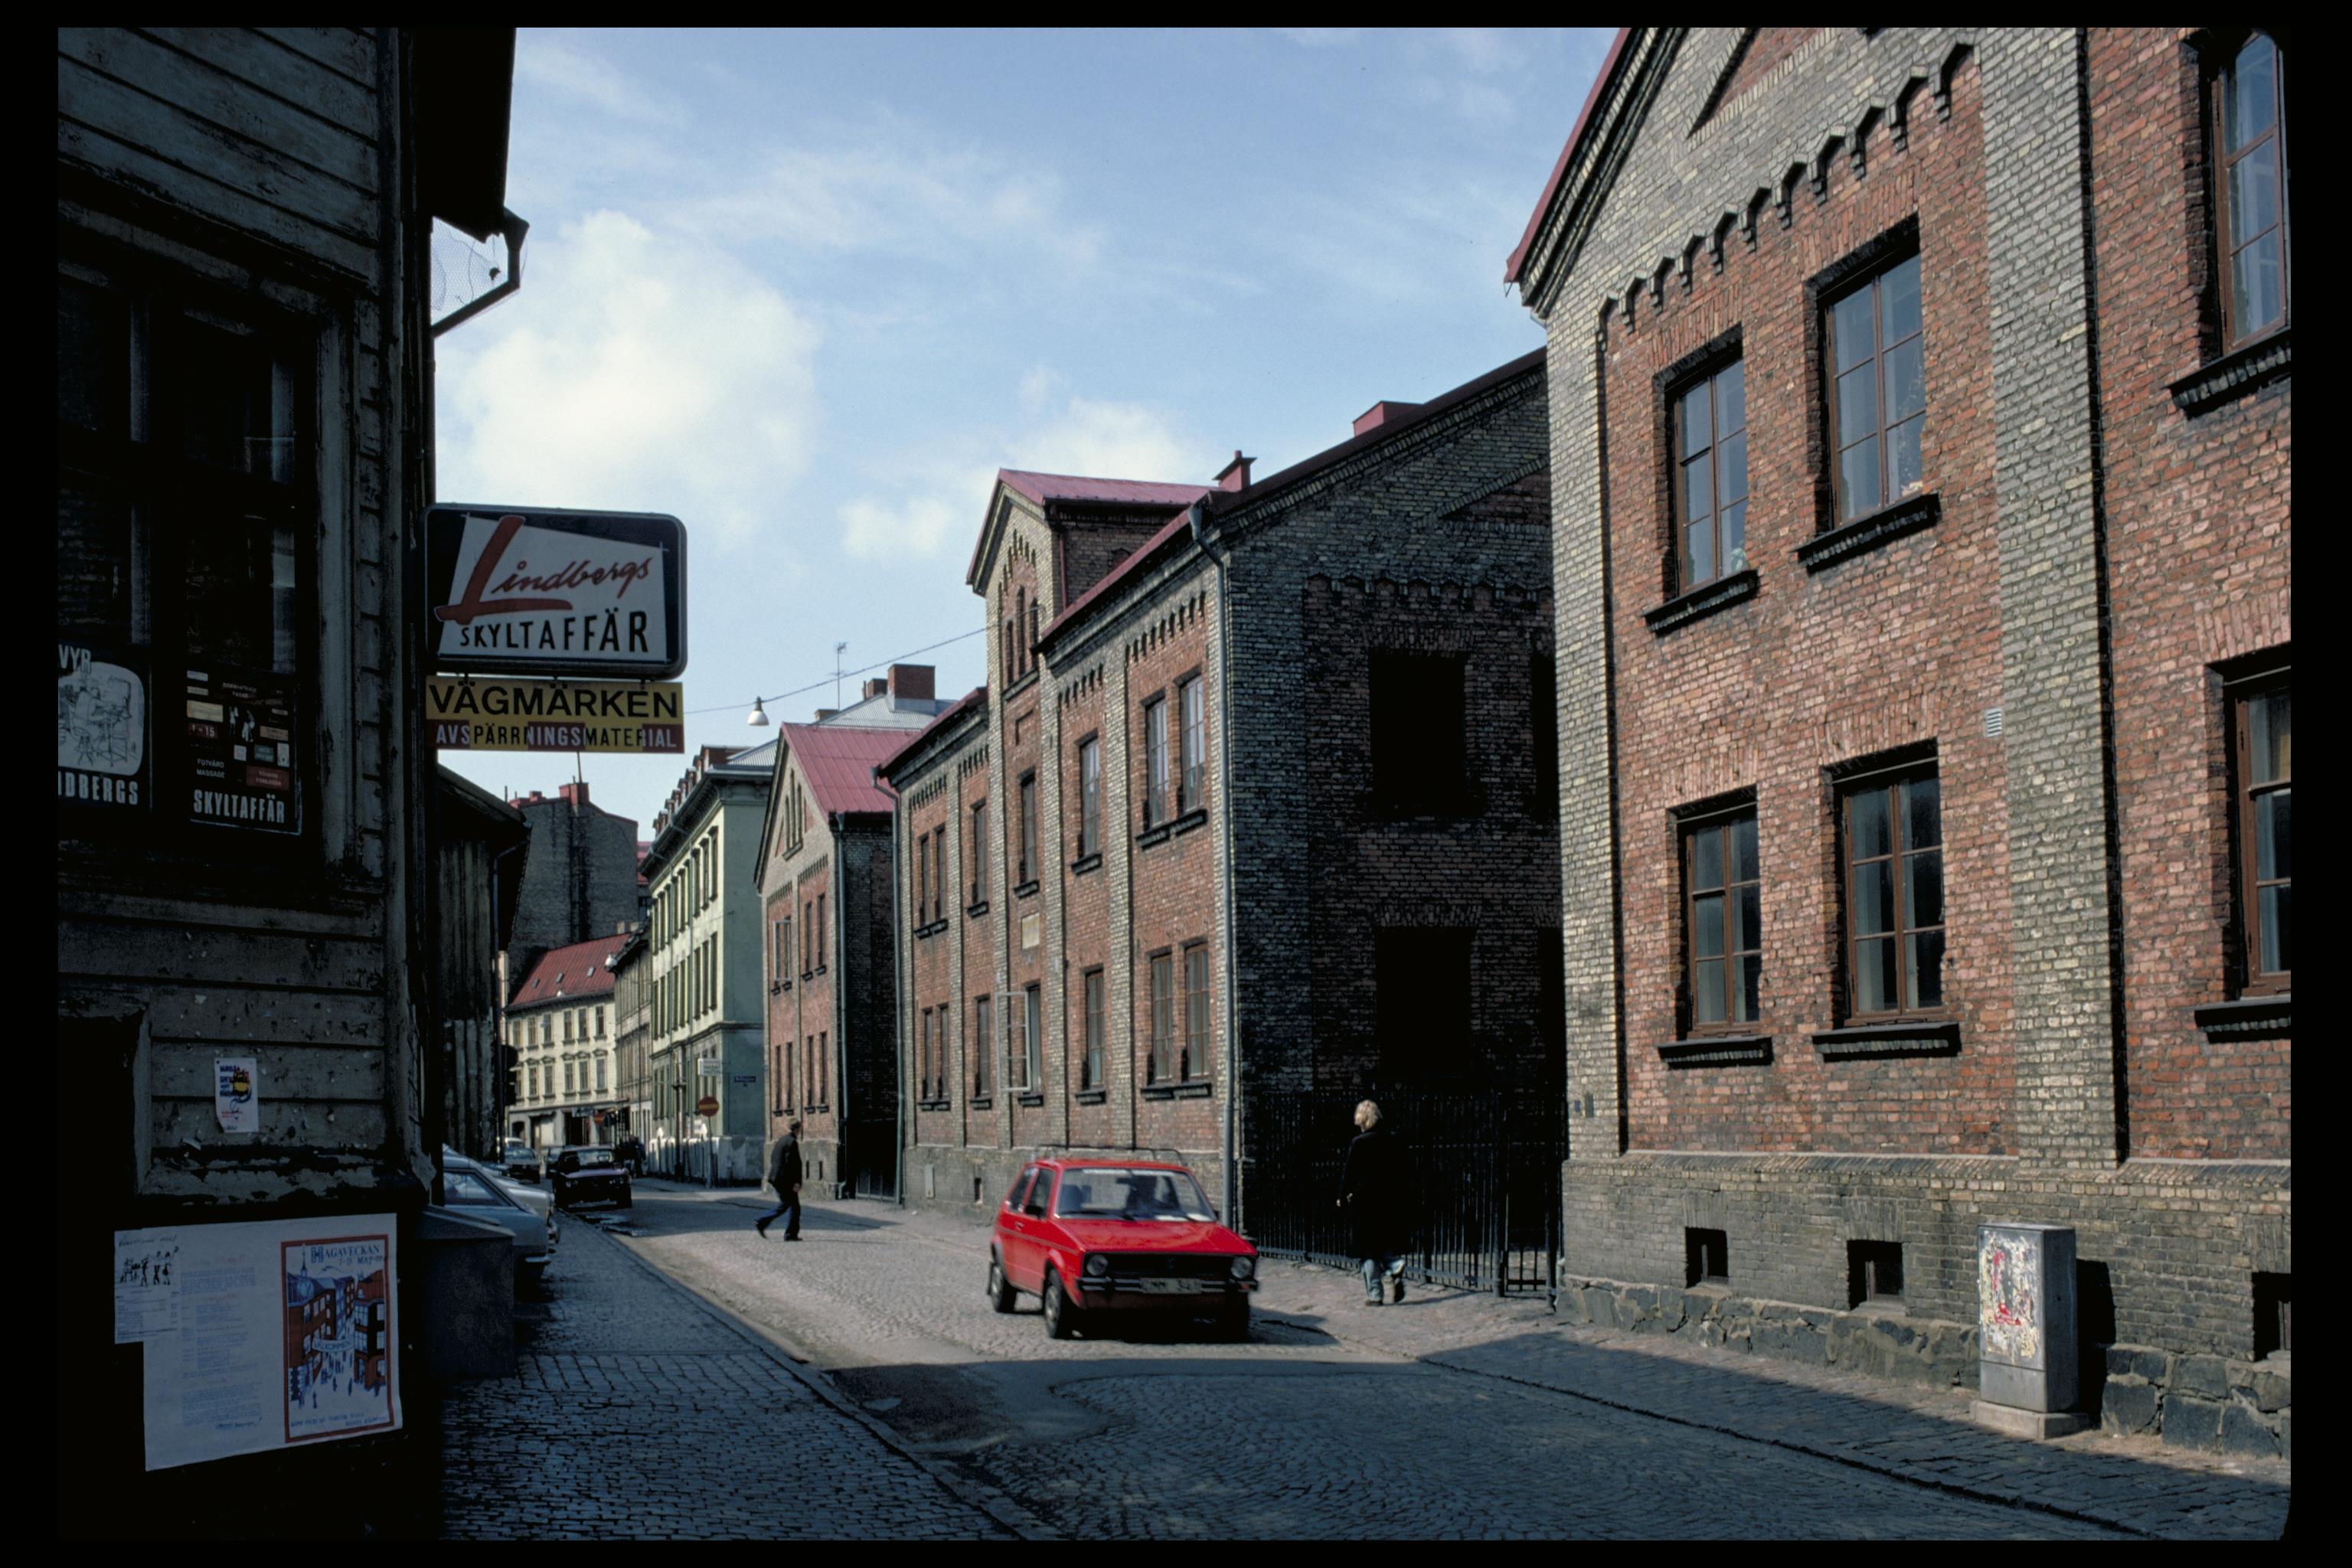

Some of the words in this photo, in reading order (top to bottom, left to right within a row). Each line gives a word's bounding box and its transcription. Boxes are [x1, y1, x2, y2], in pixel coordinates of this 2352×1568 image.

[434, 514, 653, 626] Lindbergs
[460, 607, 648, 653] SKYLTAFFÄR
[429, 681, 678, 718] VÄGMÄRKEN
[436, 723, 678, 748] AVSPÄRRNINGSMATERIAL
[196, 768, 226, 779] MASSAGE
[194, 789, 285, 825] SKYLTAFFÄR
[311, 1244, 381, 1263] HAGAVECKAN
